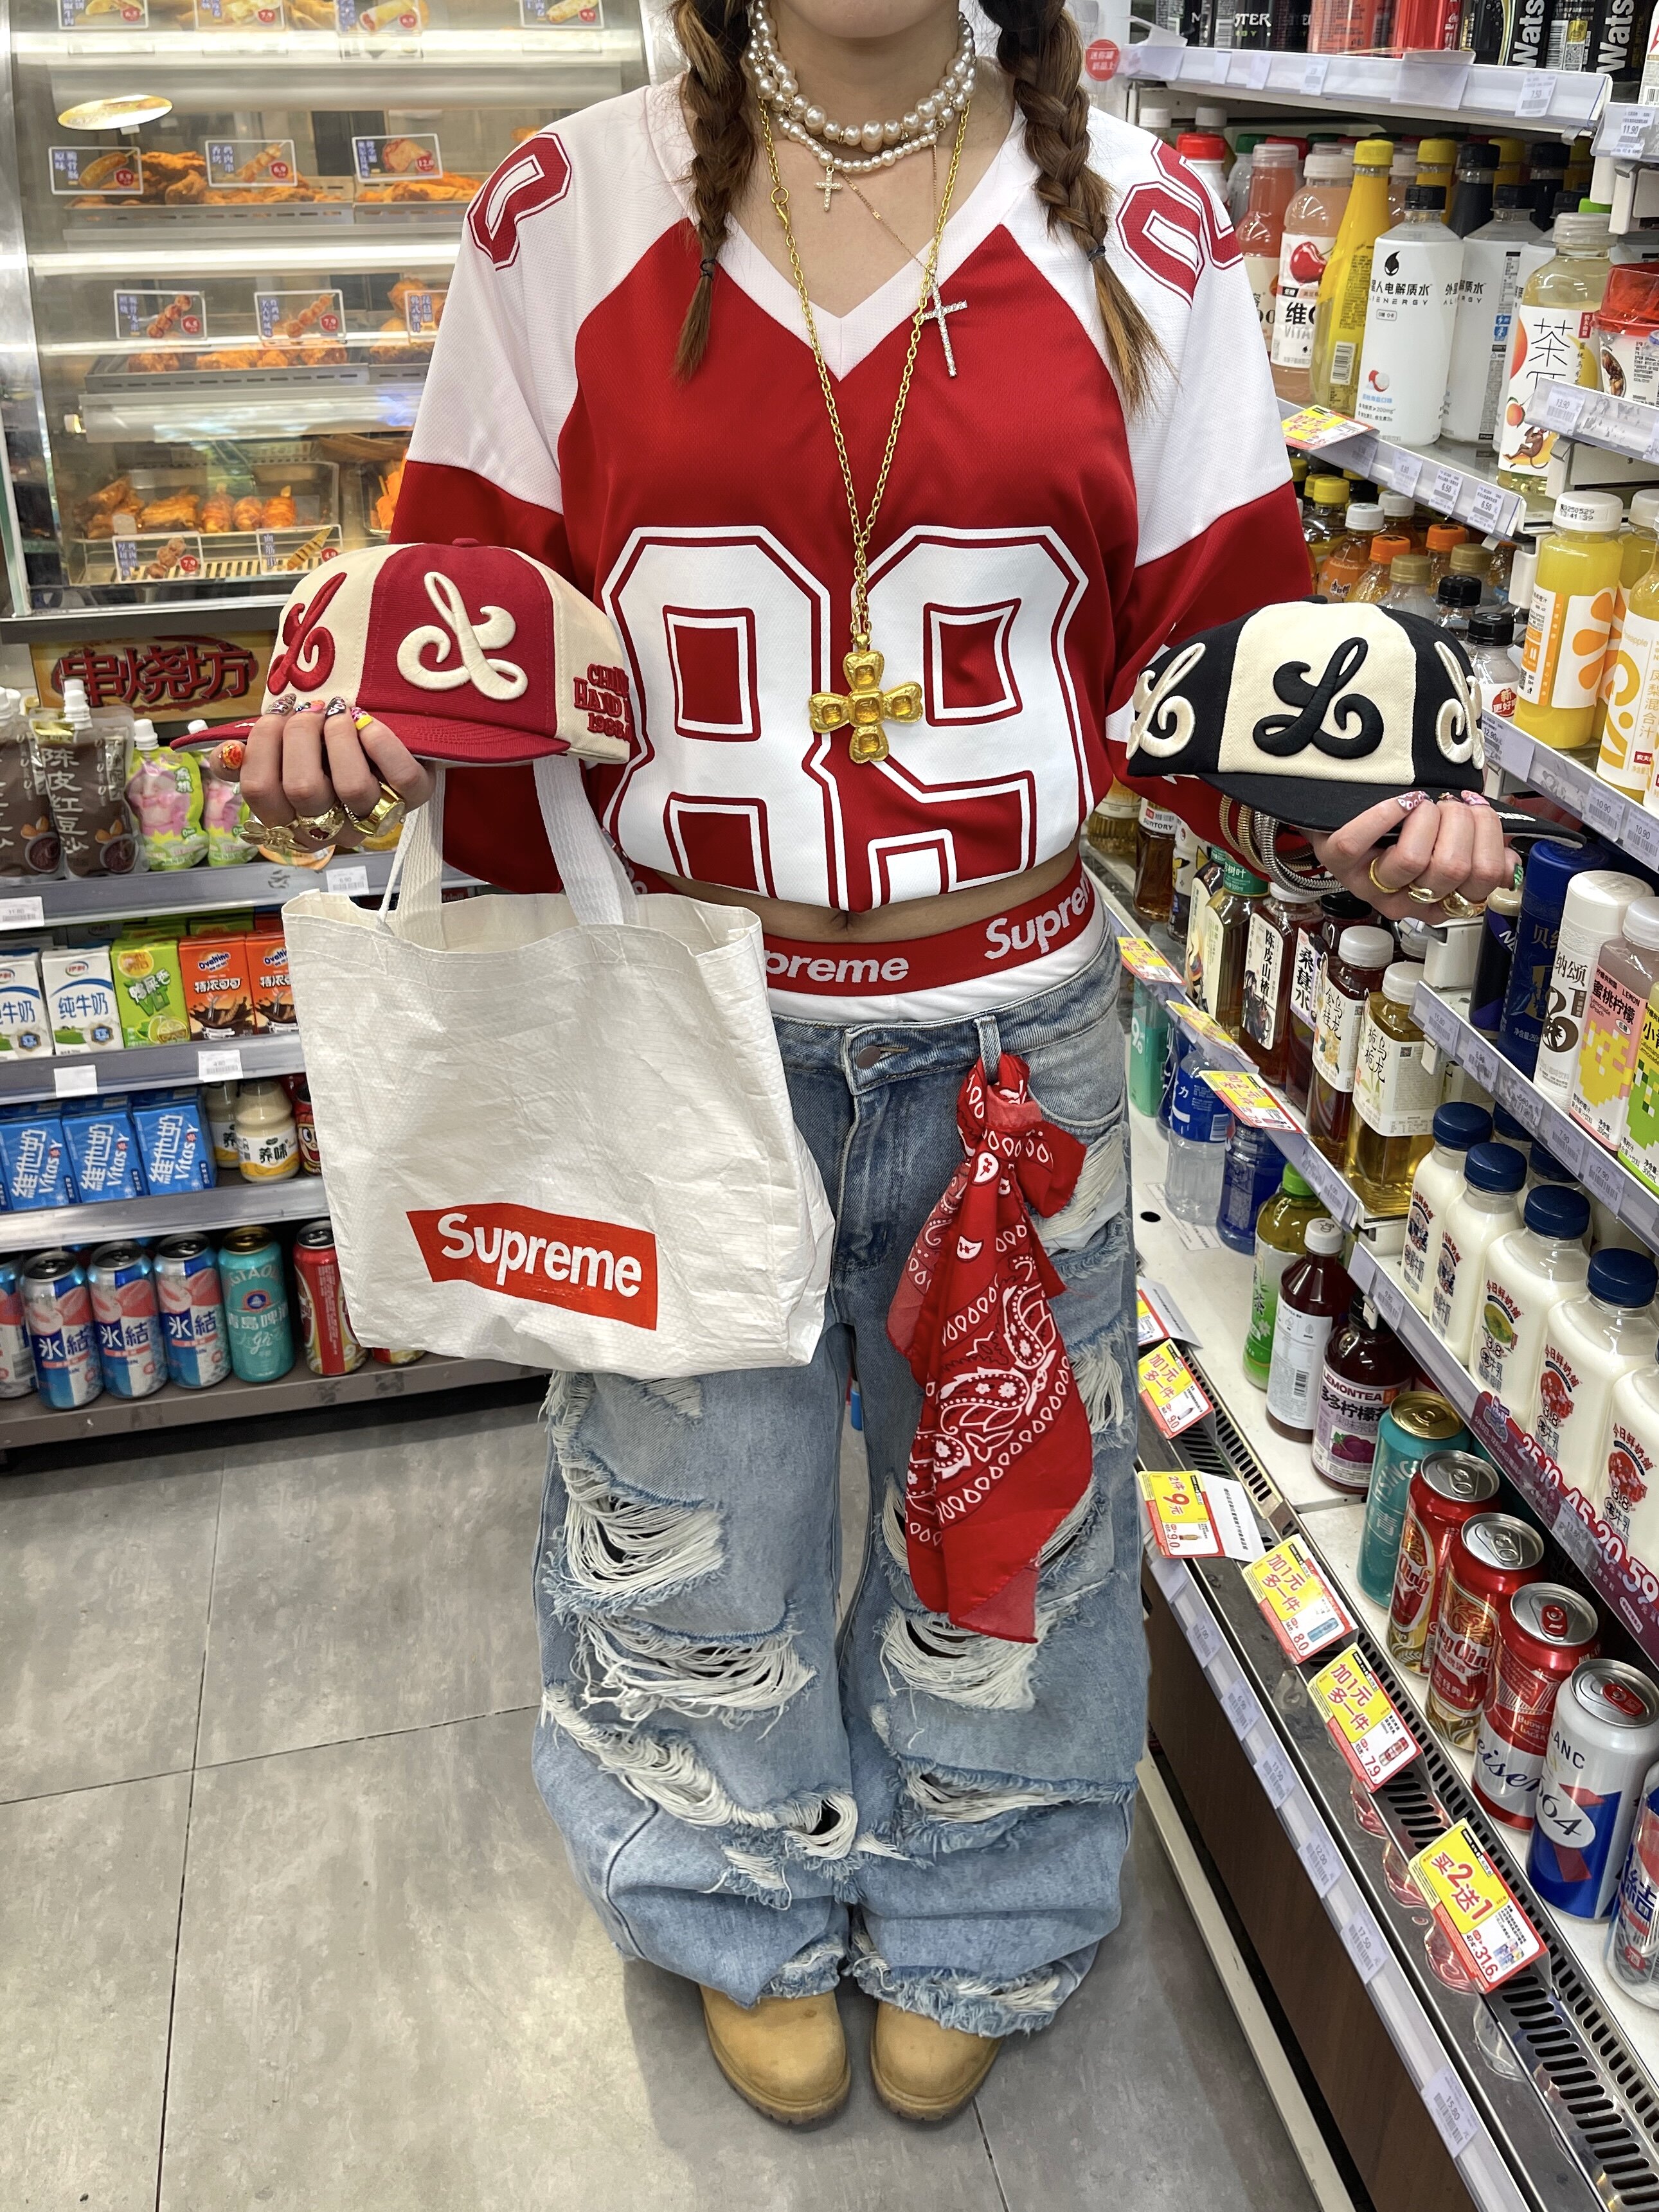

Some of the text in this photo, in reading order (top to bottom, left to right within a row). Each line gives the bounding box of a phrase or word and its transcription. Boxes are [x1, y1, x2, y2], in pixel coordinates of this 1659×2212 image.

[1440, 483, 1453, 494] 6.50
[1480, 500, 1493, 512] 6.50
[58, 643, 252, 708] 串烧坊
[1500, 688, 1512, 701] 新
[601, 526, 1095, 913] 89
[1596, 798, 1612, 814] 10.90
[1635, 823, 1651, 840] 10.90
[199, 951, 231, 970] Ovaltine
[58, 990, 109, 1020] 纯牛奶
[1592, 979, 1636, 1025] 蜜桃柠檬
[1622, 988, 1640, 1007] LEMON
[0, 1000, 36, 1025] 牛奶
[437, 1212, 642, 1298] Supreme
[1486, 1279, 1522, 1319] 今日鲜奶铺
[1147, 1353, 1180, 1382] 加1元
[1544, 1343, 1580, 1388] 今日鲜奶铺
[1143, 1370, 1175, 1399] 多一件
[1323, 1370, 1383, 1402] LEMONTEA
[1167, 1414, 1180, 1430] 9.0
[1612, 1422, 1654, 1472] 今日鲜奶铺
[1168, 1476, 1185, 1491] 2件
[1169, 1505, 1184, 1515] 元
[1167, 1533, 1181, 1549] 9.0
[1266, 1553, 1306, 1591] 加1元
[1261, 1573, 1300, 1612] 多一件
[1293, 1632, 1310, 1652] 8.0
[1330, 1663, 1373, 1707] 加1元
[1327, 1687, 1369, 1731] 多一件
[1364, 1755, 1381, 1777] 7.9
[1541, 1793, 1583, 1837] 64
[1431, 1851, 1494, 1920] 买2送1
[1475, 1946, 1499, 1977] 31.6
